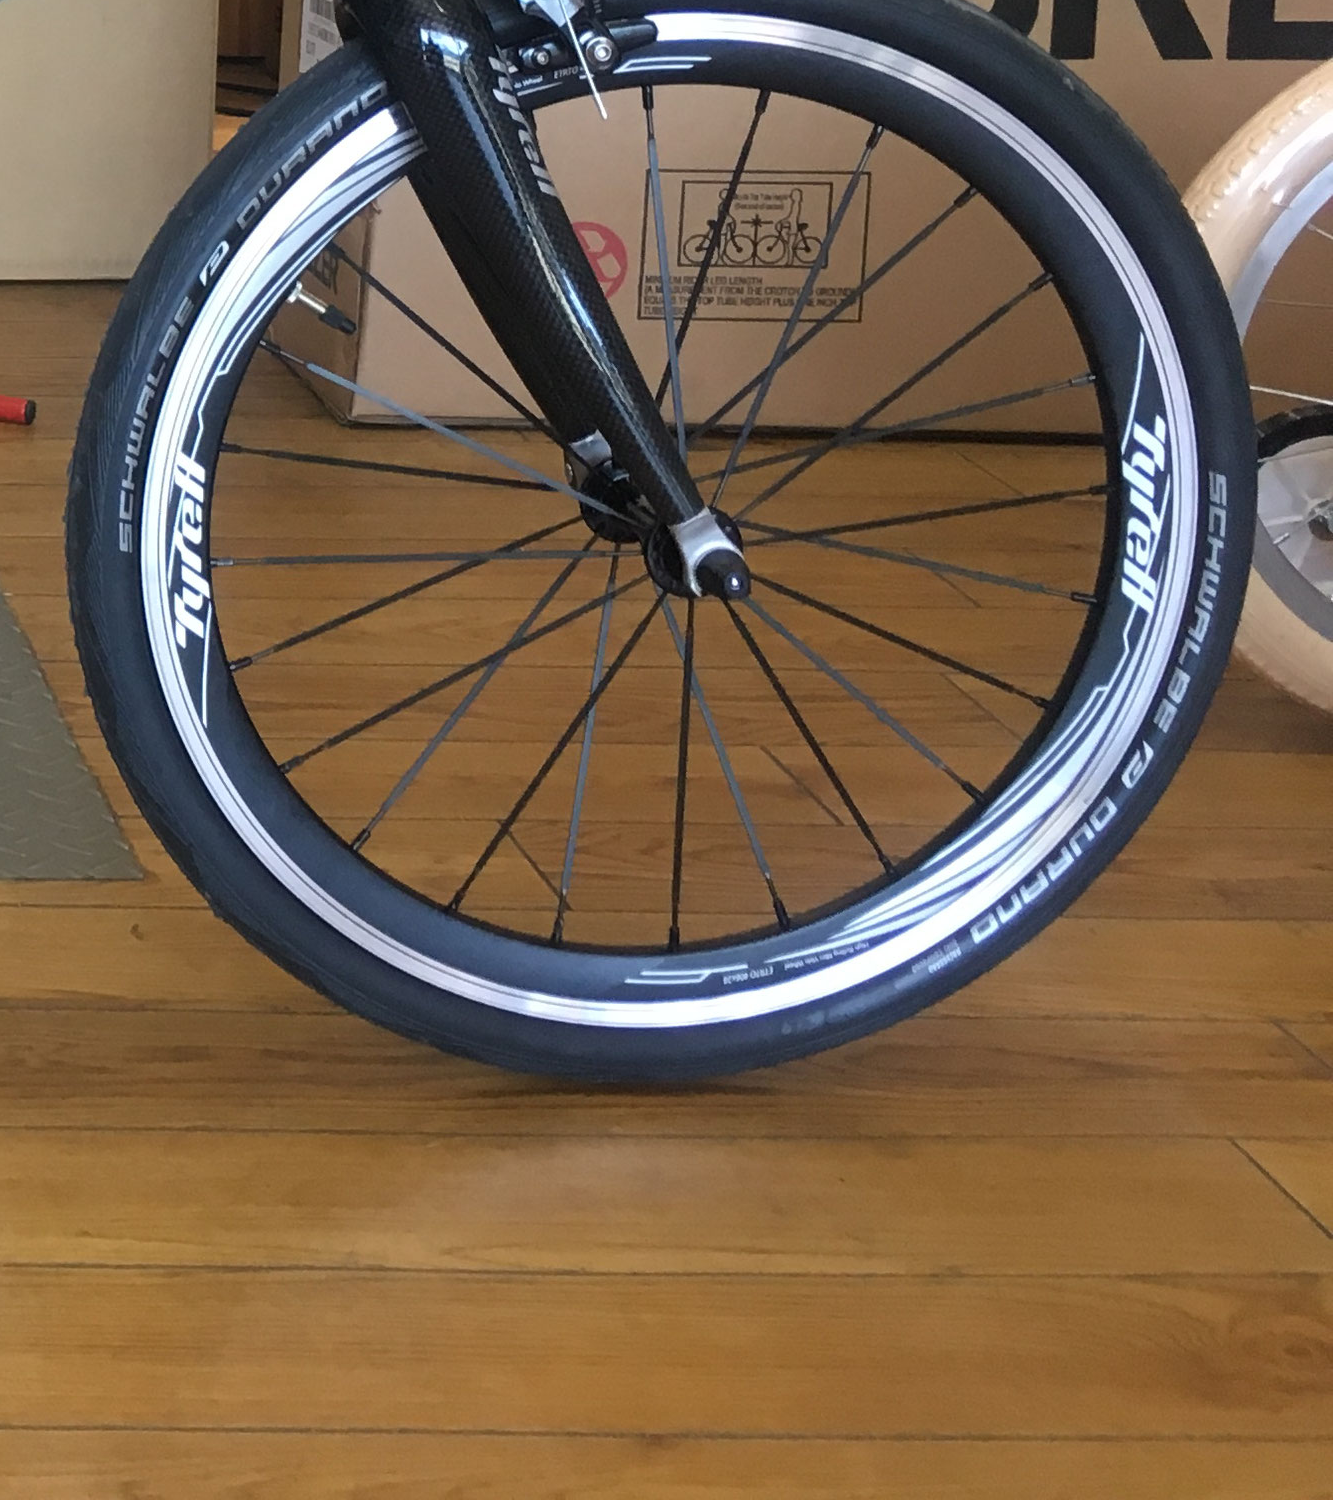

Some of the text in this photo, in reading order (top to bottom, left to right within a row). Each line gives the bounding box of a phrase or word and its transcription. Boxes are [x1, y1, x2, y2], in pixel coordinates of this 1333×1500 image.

[235, 82, 389, 234] DURANO
[488, 55, 563, 198] Tyrell
[729, 275, 763, 285] LENGTH
[118, 295, 197, 554] SCHWALBE
[164, 460, 211, 652] Tyrell
[1121, 415, 1166, 618] Tyrell
[1152, 472, 1227, 733] SCHWALBE
[969, 794, 1119, 945] DURANO
